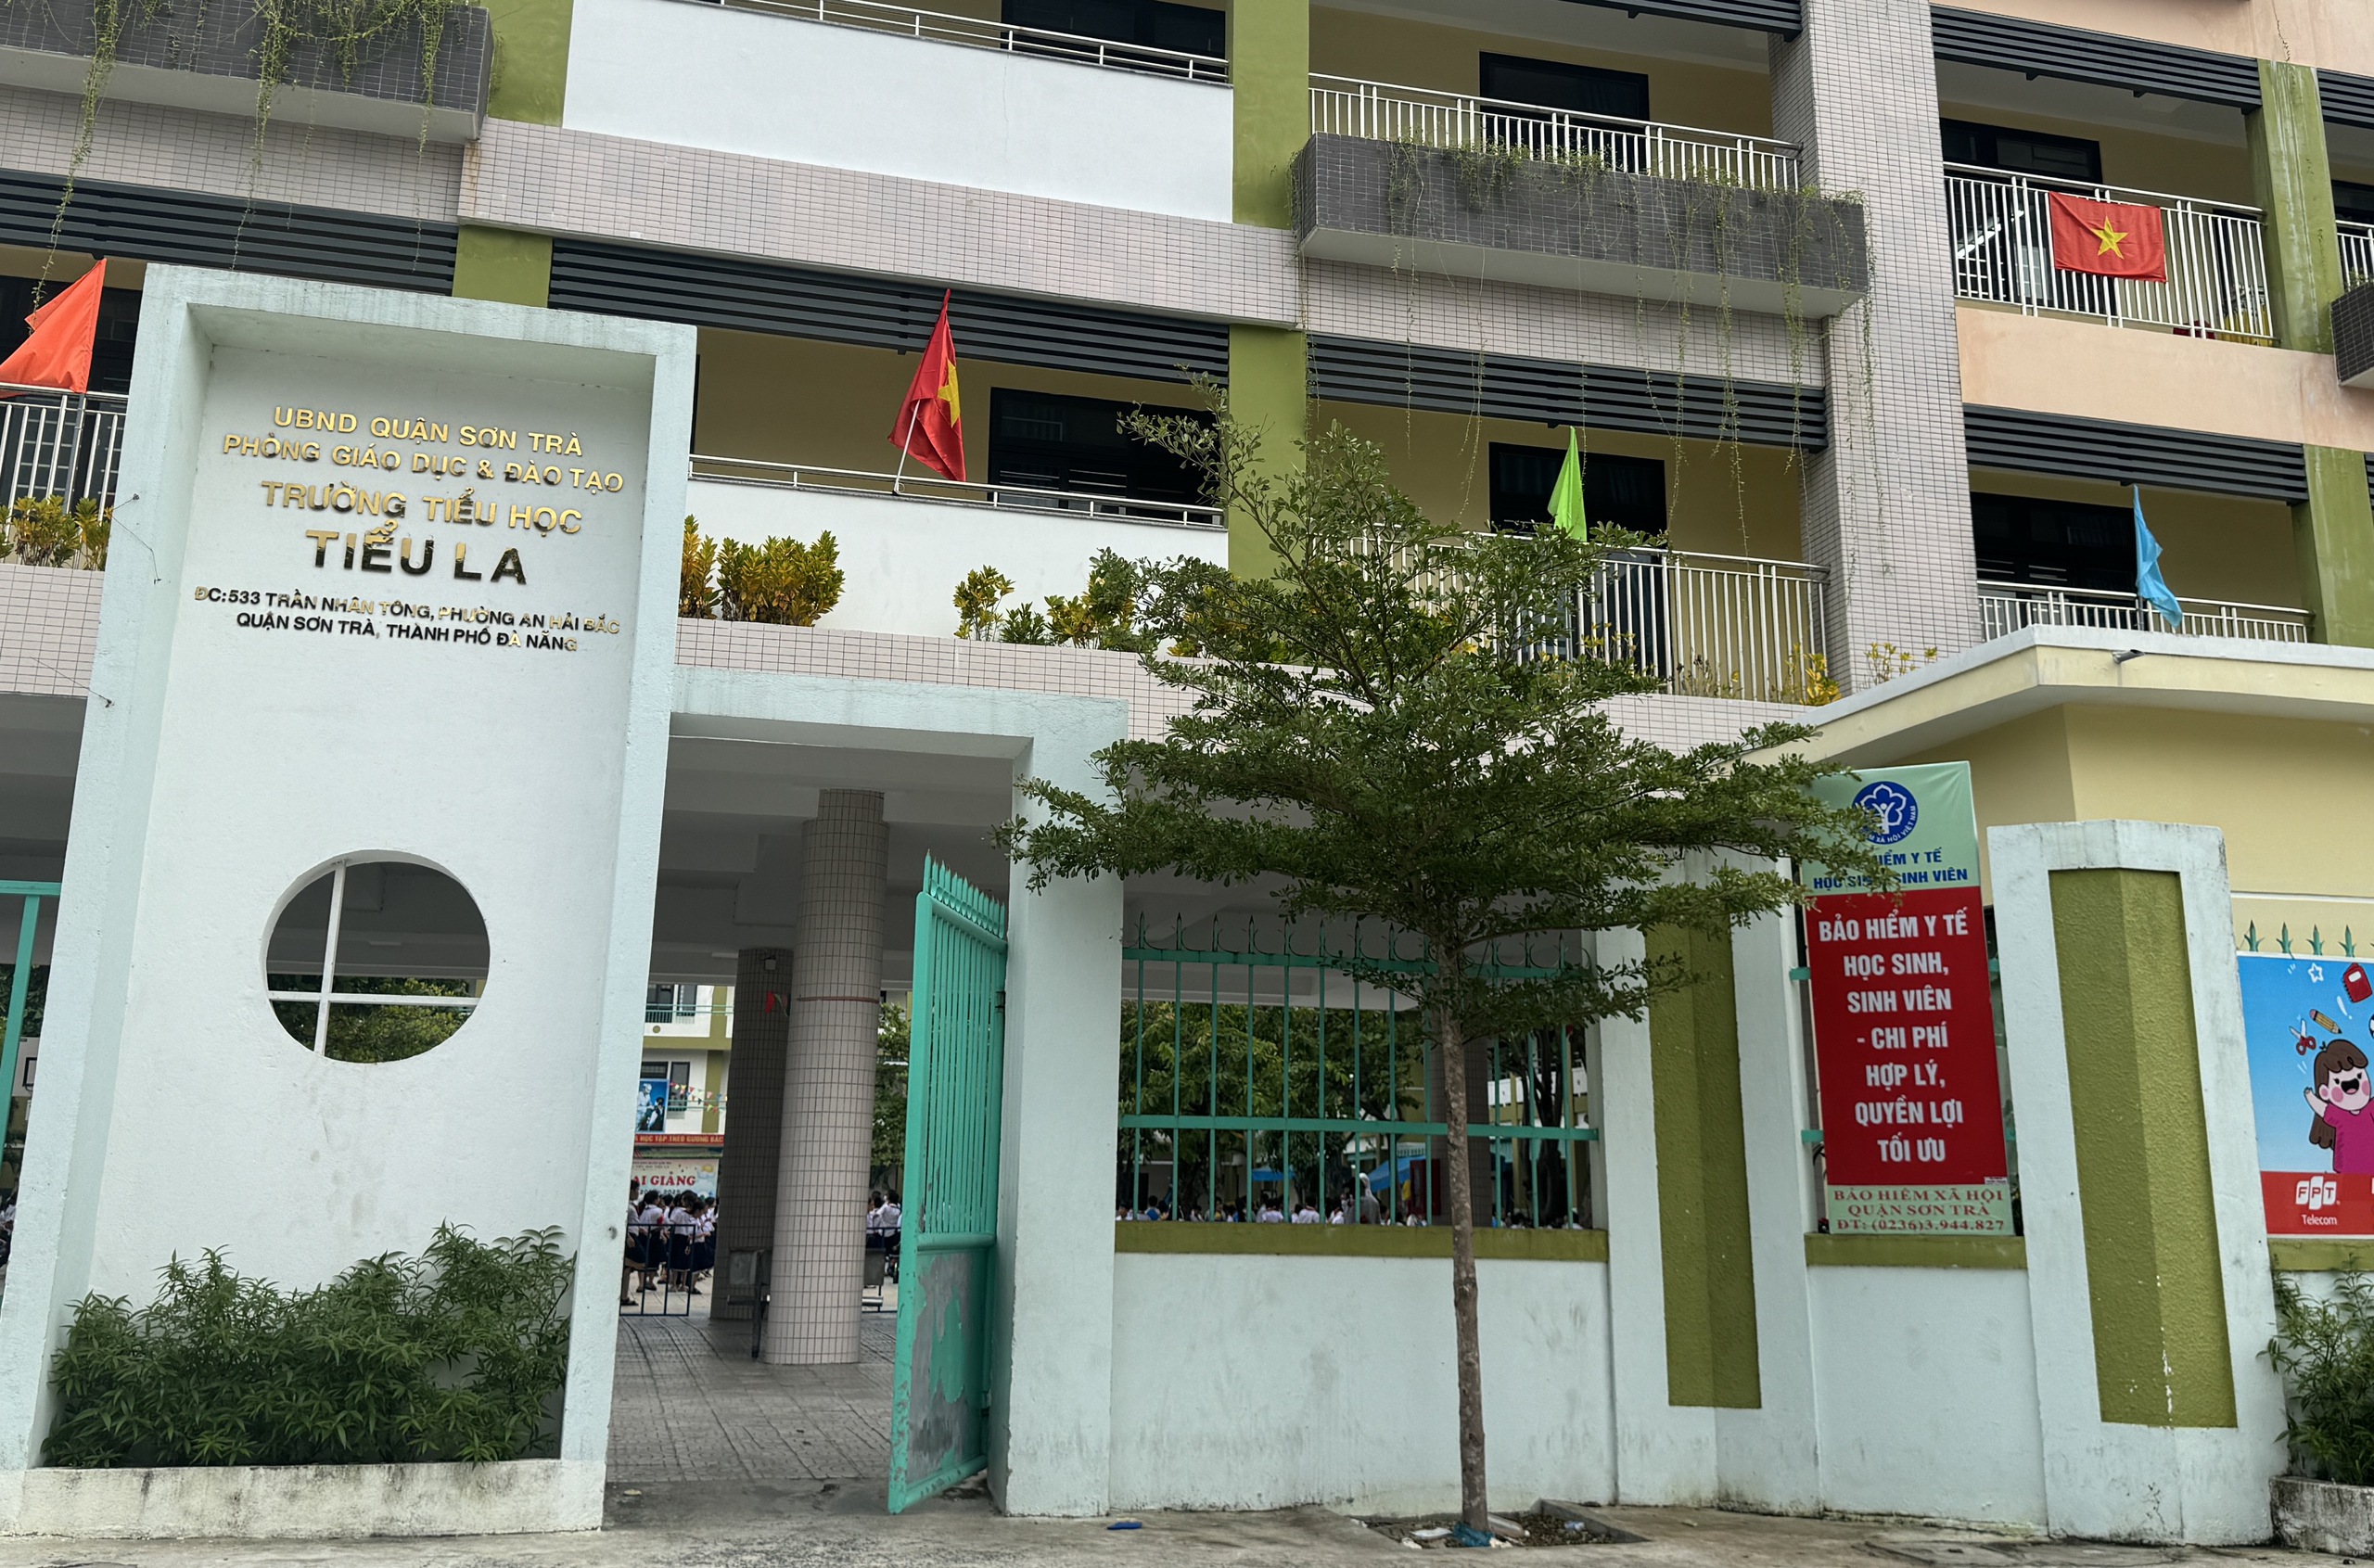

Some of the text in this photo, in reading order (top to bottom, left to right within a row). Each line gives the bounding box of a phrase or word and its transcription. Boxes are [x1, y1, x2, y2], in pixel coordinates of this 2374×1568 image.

[274, 406, 583, 457] UBND QUẬN SƠN TRÀ
[223, 432, 624, 495] PHÒNG GIÁO DỤC & ĐÀO TẠO
[261, 480, 582, 538] TRƯỜNG TIỂU HỌC
[305, 519, 528, 586] TIỂU LA
[265, 589, 318, 610] TRẦN
[322, 596, 375, 615] NHÂN
[379, 600, 435, 621] TÔNG,
[438, 606, 515, 627] PHƯỜNG
[519, 613, 545, 629] AN
[549, 612, 580, 631] HẢI
[583, 613, 620, 634] BẮC
[236, 610, 290, 631] QUẬN
[293, 616, 334, 633] SƠN
[386, 623, 449, 642] THÀNH
[453, 626, 491, 645] PHỐ
[496, 631, 522, 647] ĐÀ
[1911, 852, 1920, 864] Y
[1924, 847, 1943, 863] TẾ
[1813, 876, 1843, 891] HỌC
[1932, 867, 1968, 881] VIÊN
[1818, 906, 1969, 942] BẢO HIỂM Y TẾ
[1843, 951, 1949, 981] HỌC SINH,
[1846, 984, 1952, 1013] SINH VIÊN
[1870, 1026, 1907, 1050] CHI
[1911, 1021, 1948, 1049] PHÍ
[1865, 1058, 1946, 1091] HỢP LÝ,
[1855, 1094, 1964, 1128] QUYỀN LỢI
[1877, 1132, 1946, 1163] TỐI ƯU
[1833, 1189, 1873, 1201] BẢO
[1934, 1188, 1960, 1201] XÃ
[1966, 1188, 2004, 1204] HỘI
[1847, 1203, 1990, 1218] QUẬN SƠN TRÀ
[1836, 1218, 2005, 1231] ĐT: (0236)3.944.827
[2301, 1213, 2338, 1226] Telecom
